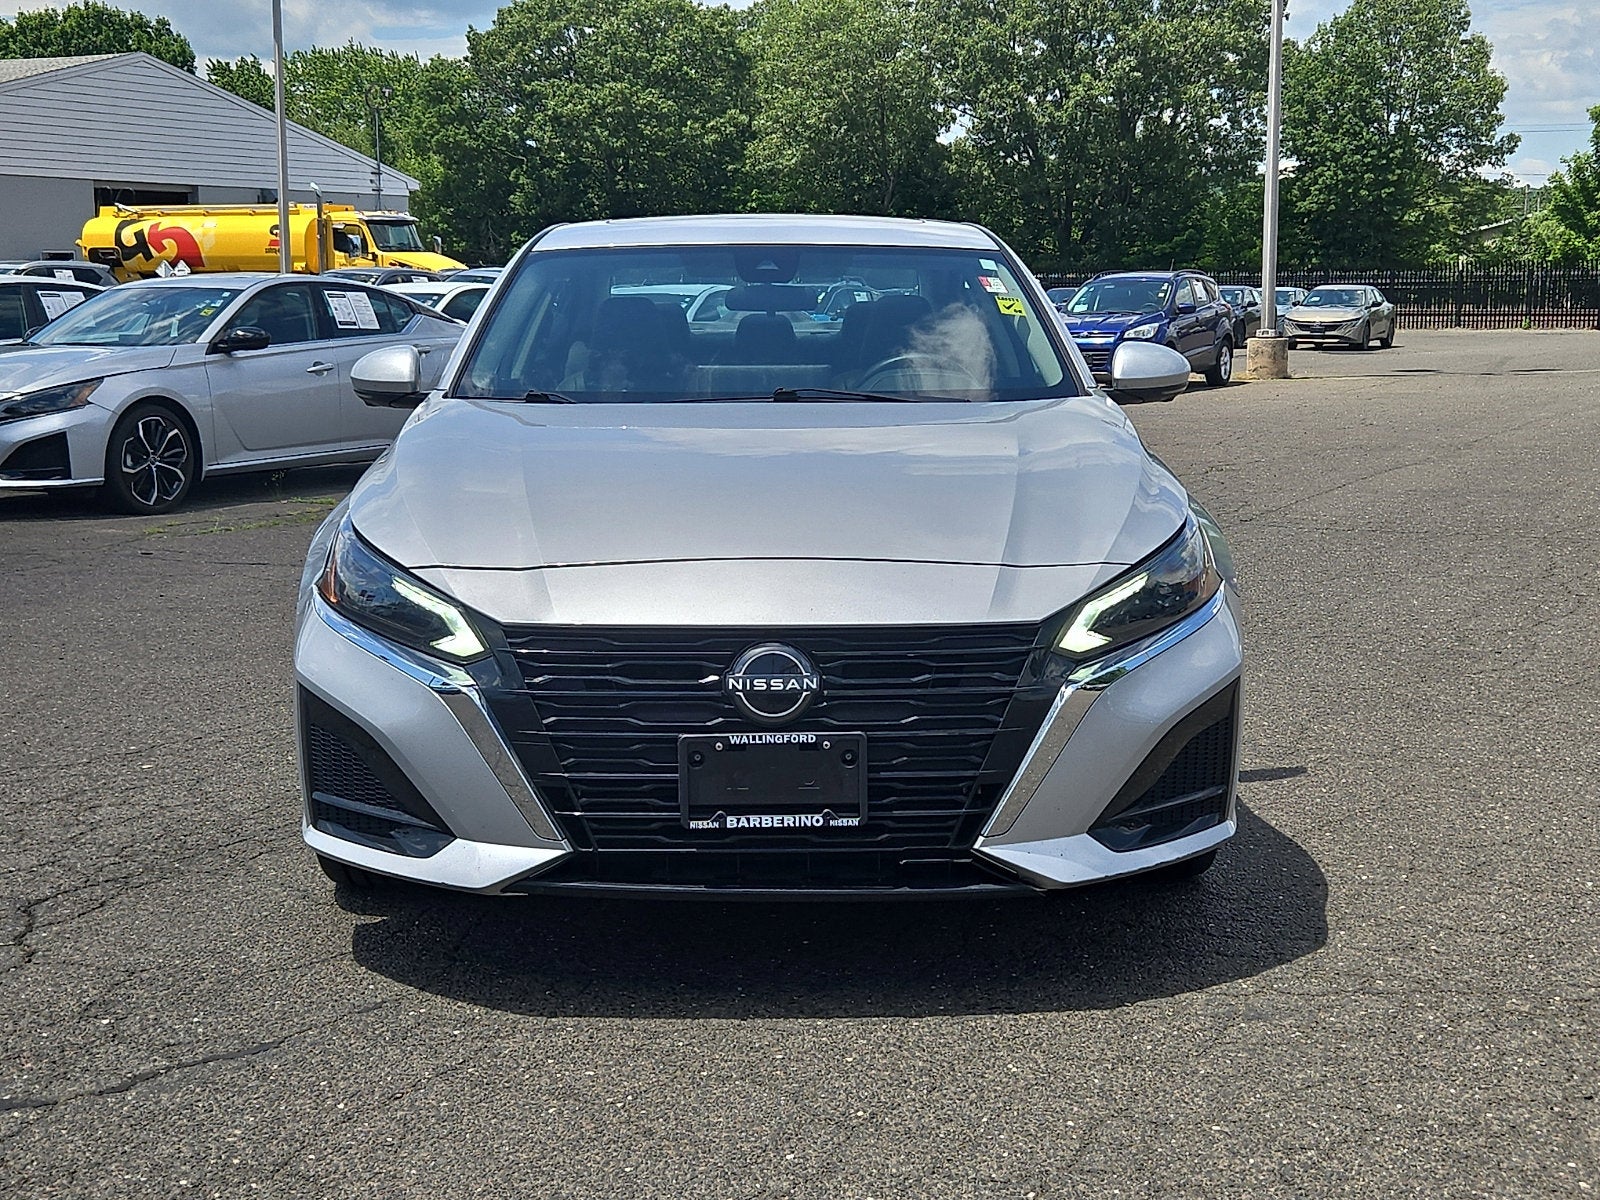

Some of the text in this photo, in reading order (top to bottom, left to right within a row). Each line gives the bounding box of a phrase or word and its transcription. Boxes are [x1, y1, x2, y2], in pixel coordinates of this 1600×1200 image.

[728, 678, 818, 691] NISSAN
[729, 734, 817, 745] WALLINGFORD
[690, 820, 720, 829] NISSAN
[726, 815, 824, 829] BARBERINO
